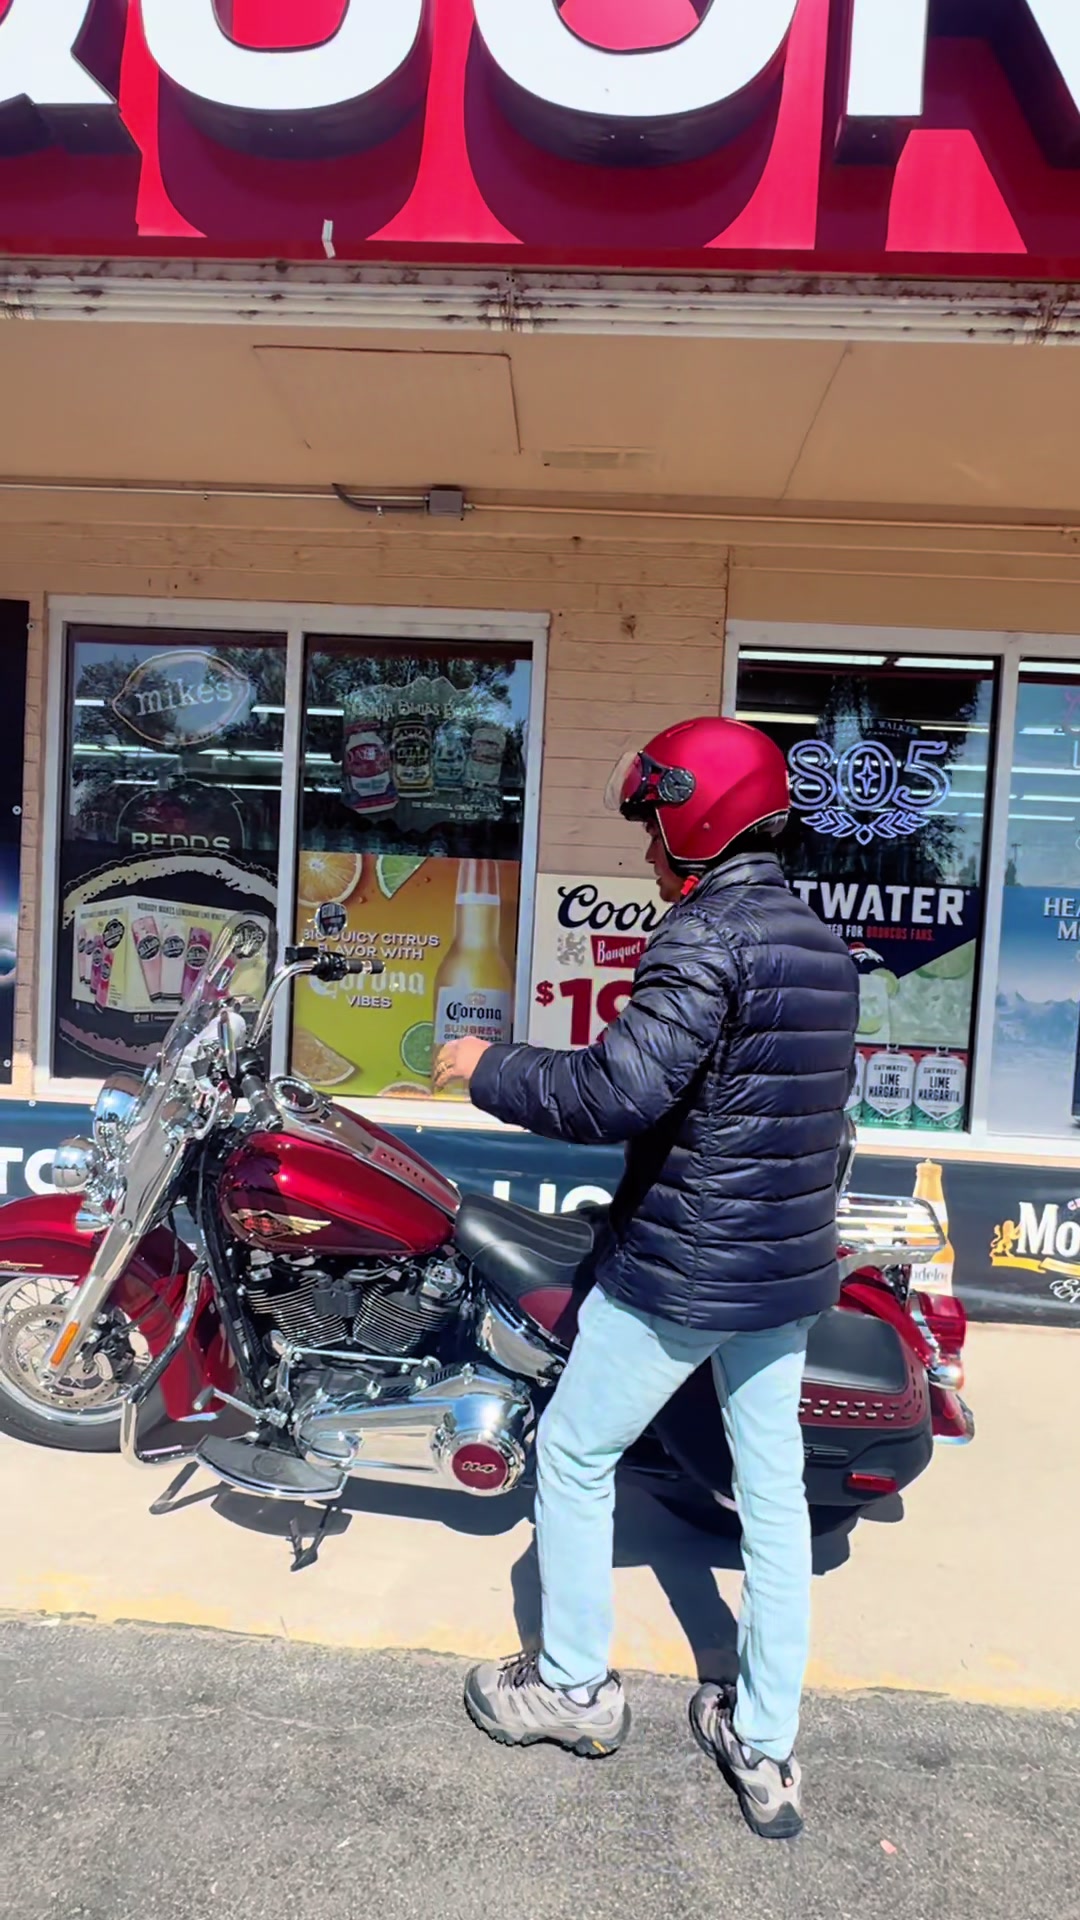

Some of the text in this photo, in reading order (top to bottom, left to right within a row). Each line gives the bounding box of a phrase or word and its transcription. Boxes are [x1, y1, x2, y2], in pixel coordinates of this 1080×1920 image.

[135, 676, 233, 716] mike's
[787, 739, 950, 812] 805
[557, 884, 675, 933] Coor
[785, 879, 965, 926] TWATER
[332, 930, 380, 944] JUICY
[381, 932, 440, 946] CITRUS
[846, 924, 863, 938] FOR
[380, 947, 424, 960] WITH
[596, 940, 642, 964] Banquet
[346, 994, 392, 1008] VIBES
[446, 1001, 502, 1023] Corona
[880, 1072, 901, 1086] LIME
[929, 1076, 950, 1089] LIME
[868, 1085, 910, 1099] MARGARITA
[918, 1089, 960, 1102] MARGARITA
[462, 1461, 498, 1474] 114
